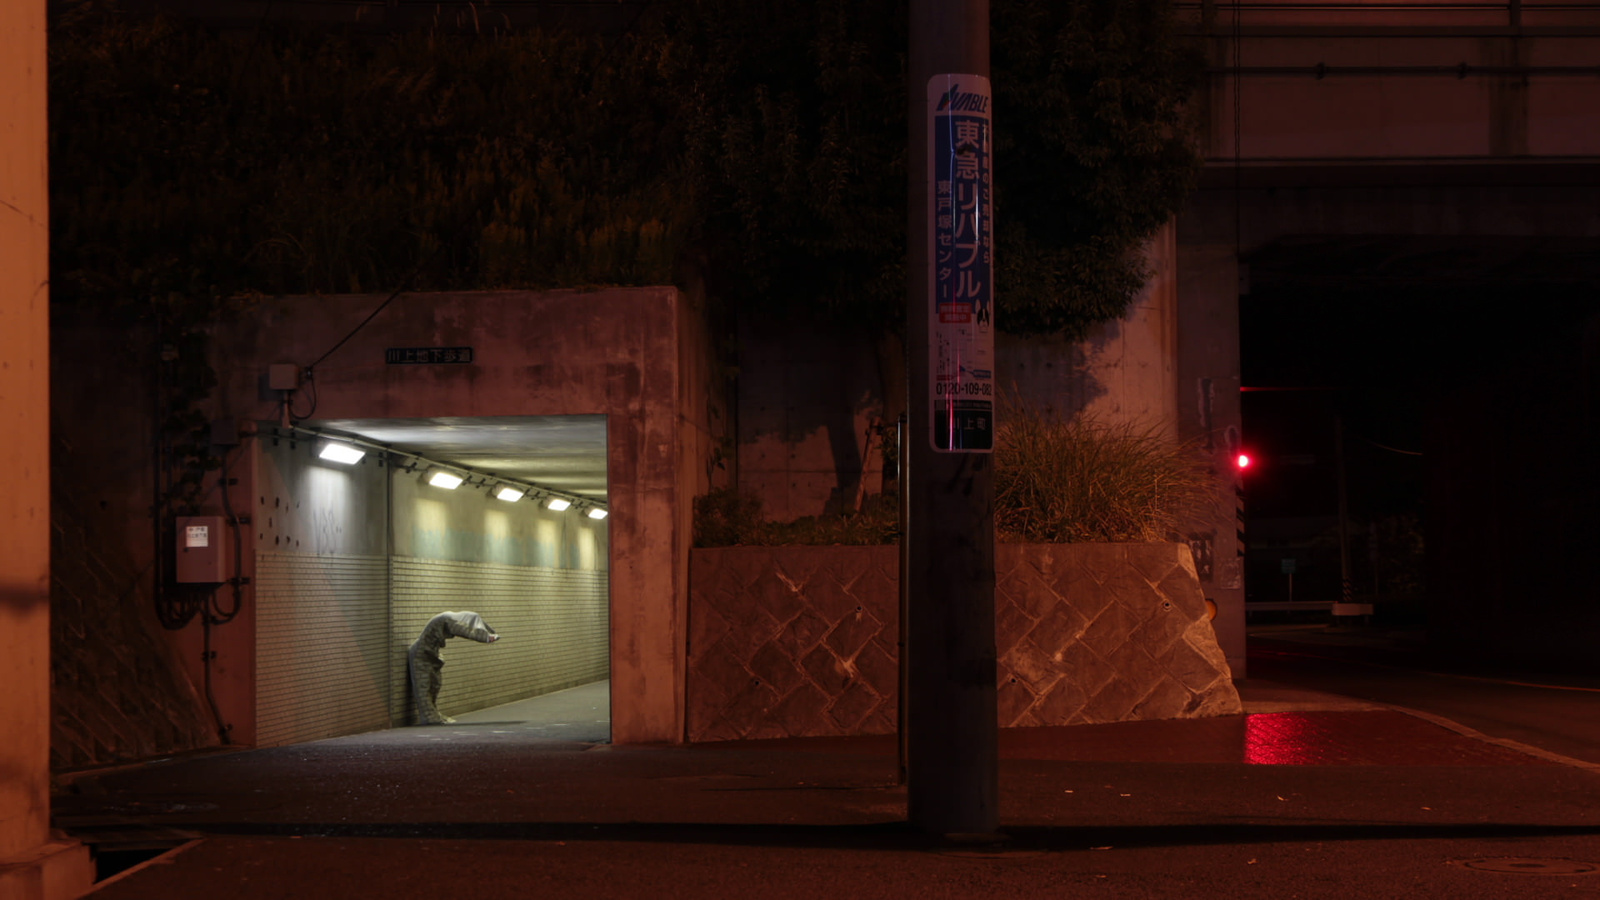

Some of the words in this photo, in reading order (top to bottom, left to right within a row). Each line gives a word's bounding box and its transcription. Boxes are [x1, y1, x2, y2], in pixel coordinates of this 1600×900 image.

[937, 180, 952, 298] 東戸塚センター
[954, 119, 982, 298] 東急リバブル
